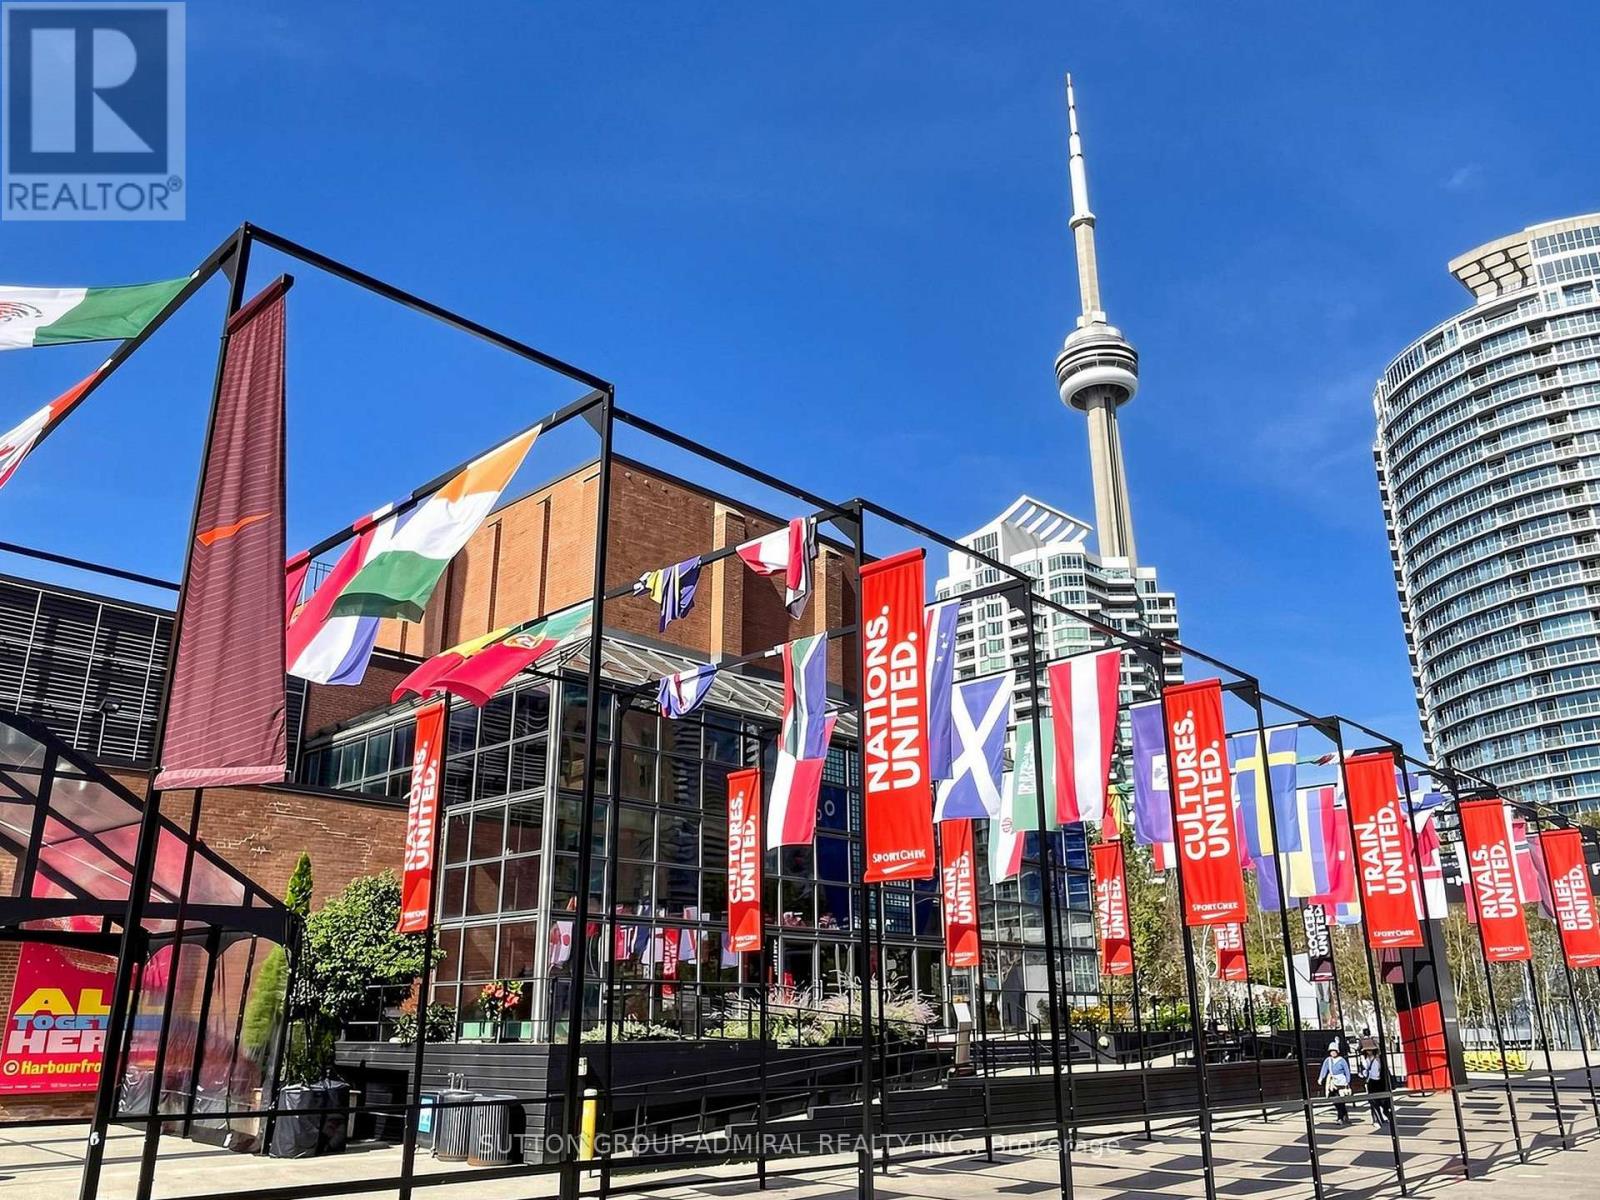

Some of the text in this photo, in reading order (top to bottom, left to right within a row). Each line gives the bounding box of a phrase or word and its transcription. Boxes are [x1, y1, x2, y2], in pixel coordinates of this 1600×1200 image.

[864, 604, 891, 793] NATIONS.
[890, 631, 921, 790] UNITED.
[415, 759, 438, 871] UNITED.
[1173, 710, 1205, 861] CULTURES.
[1200, 740, 1230, 858] UNITED.
[741, 814, 757, 902] UNITED.
[957, 850, 973, 925] UNITED.
[1353, 815, 1386, 896] TRAIN.
[1376, 801, 1408, 895] UNITED.
[1472, 844, 1500, 919] RIVALS.
[1489, 840, 1519, 918] UNITED.
[1111, 876, 1126, 939] UNITED.
[1554, 875, 1578, 931] BELIEF.
[1568, 864, 1594, 930] UNITED.
